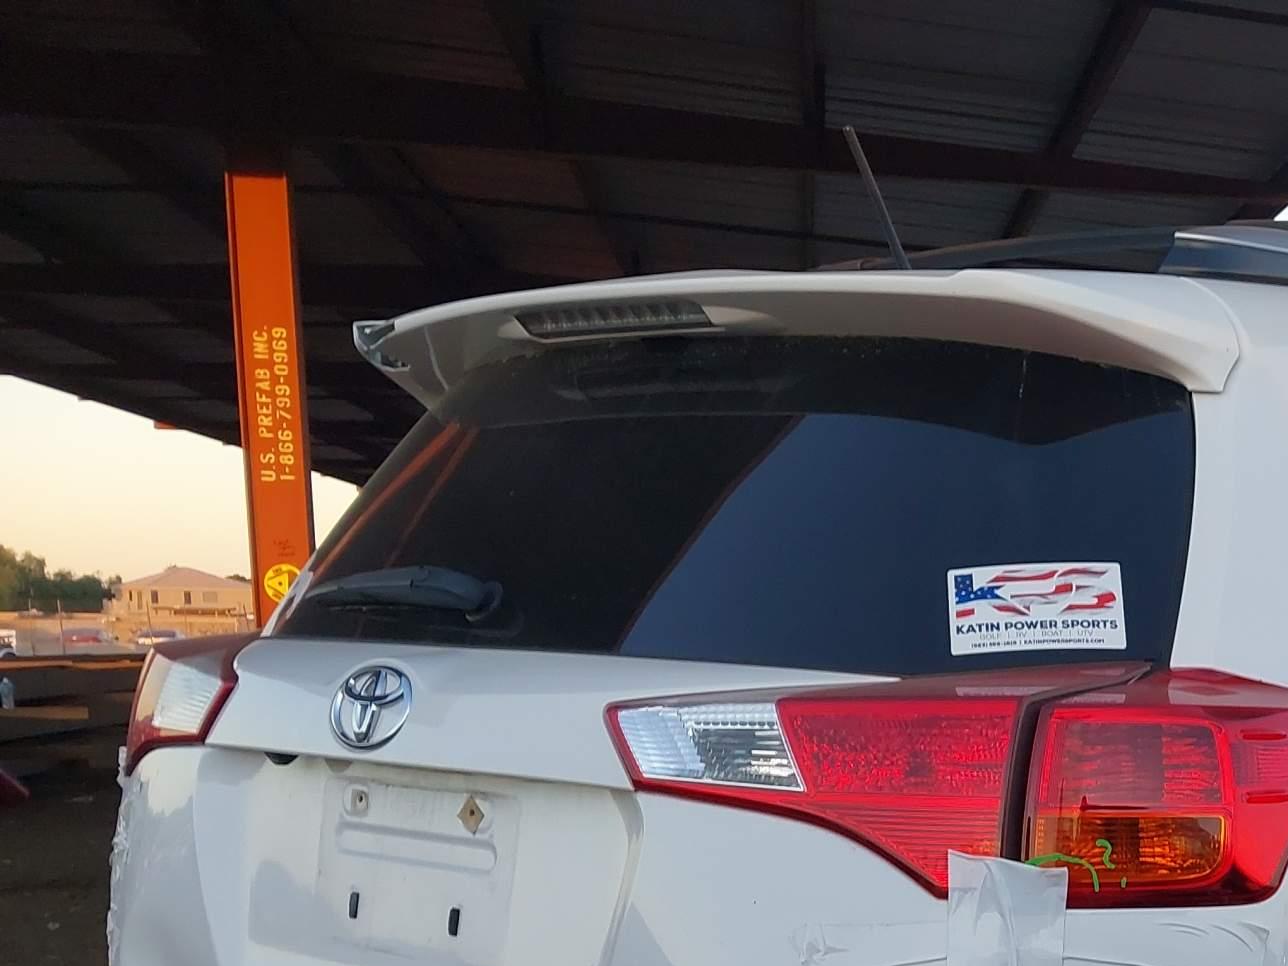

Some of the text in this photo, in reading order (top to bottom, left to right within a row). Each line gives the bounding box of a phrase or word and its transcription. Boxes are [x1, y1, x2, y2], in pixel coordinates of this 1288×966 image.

[252, 325, 276, 482] U.S. PREFAB INC.
[272, 327, 295, 481] 1-866-799-0969
[956, 618, 1118, 635] KATIN POWER SPORTS
